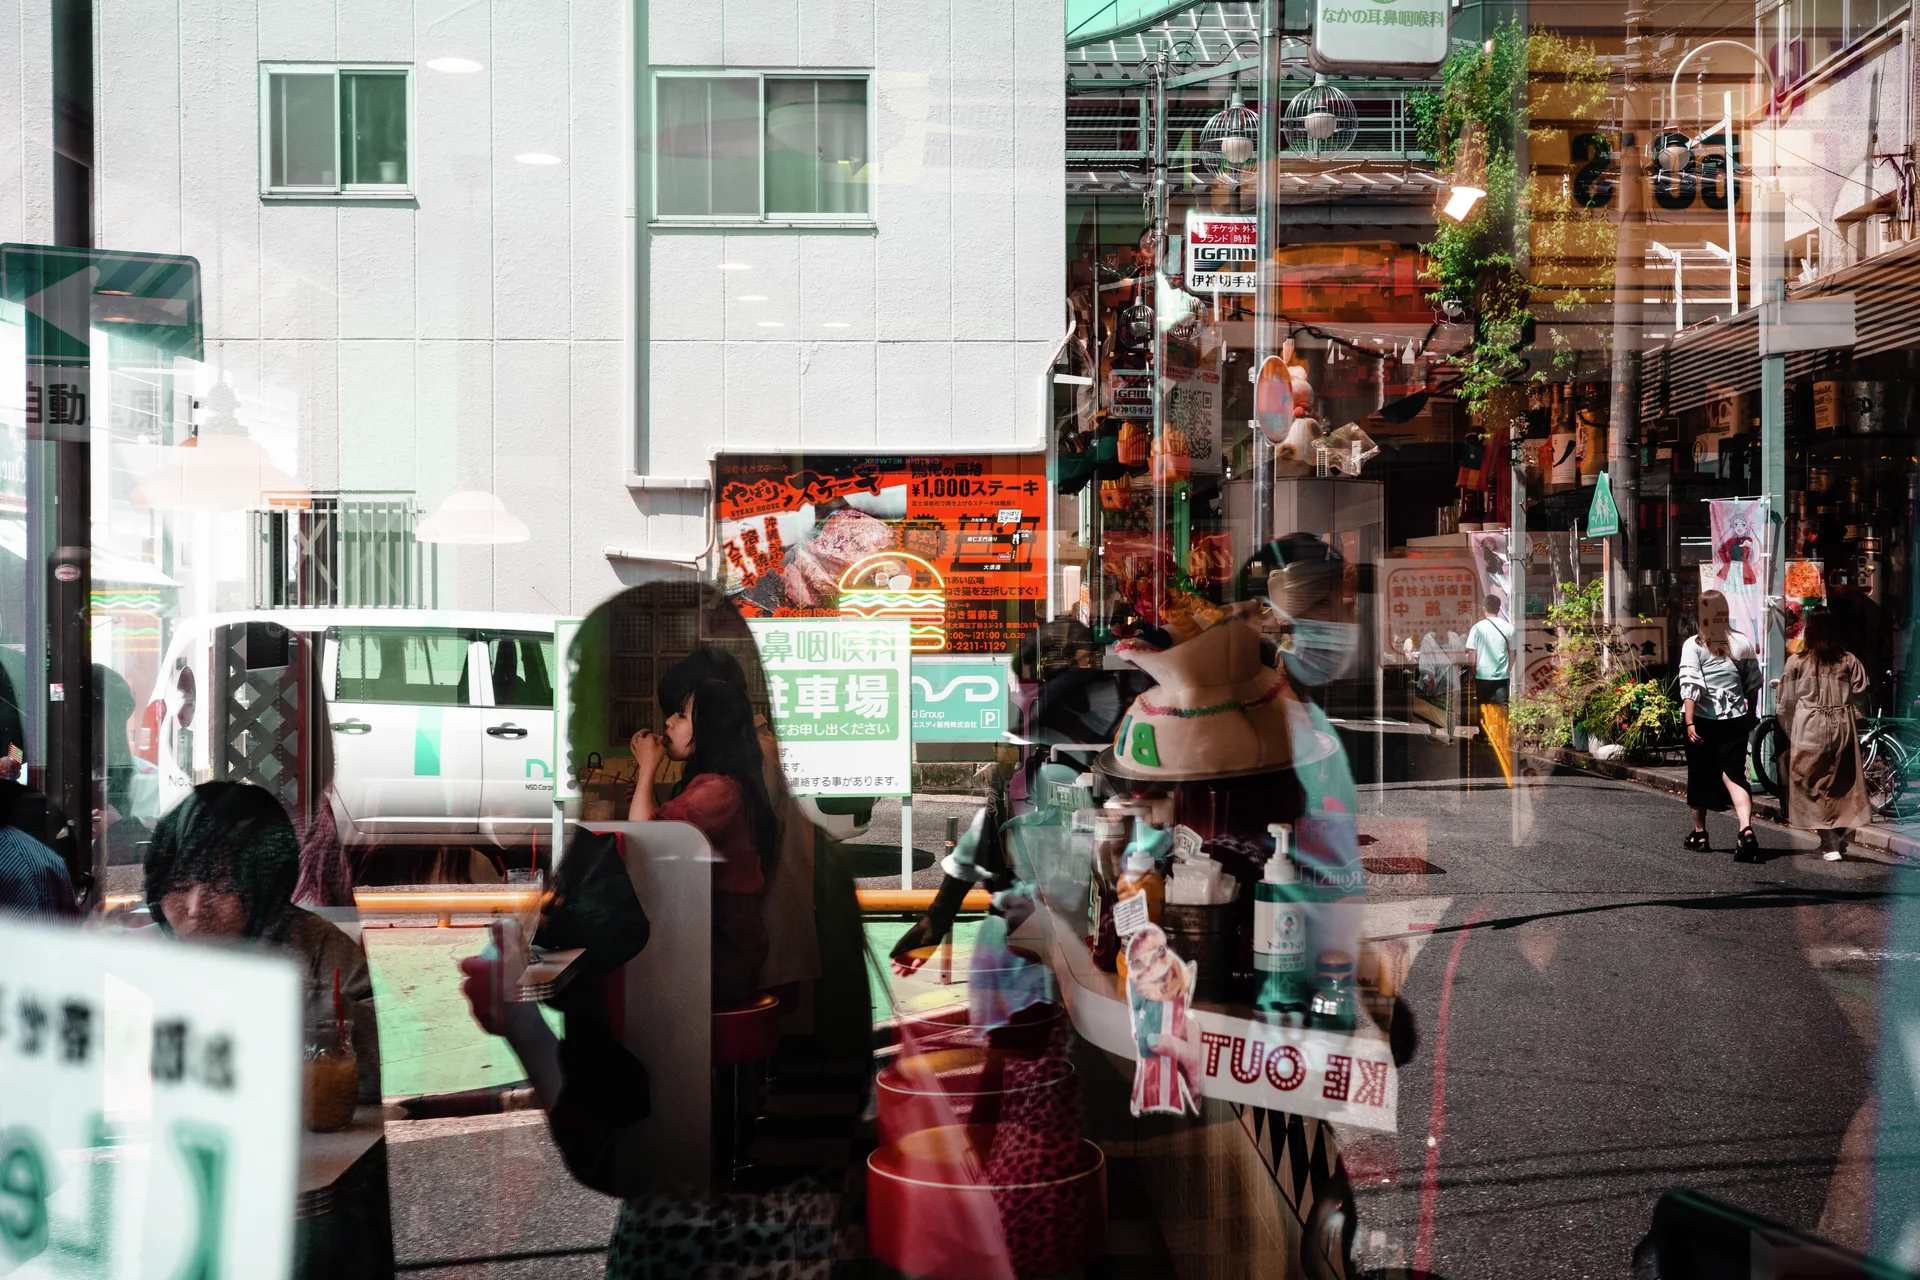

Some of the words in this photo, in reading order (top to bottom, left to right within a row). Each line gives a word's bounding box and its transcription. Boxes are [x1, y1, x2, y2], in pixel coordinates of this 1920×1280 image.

[1322, 7, 1445, 28] なかの耳鼻咽喉科
[1211, 224, 1240, 233] チケット
[1233, 234, 1251, 244] 時計
[1114, 389, 1153, 398] IGAM
[730, 507, 754, 517] STEAK
[756, 502, 780, 513] HOUSE
[723, 542, 757, 588] ステーキ
[919, 711, 945, 719] Group
[985, 711, 996, 726] P
